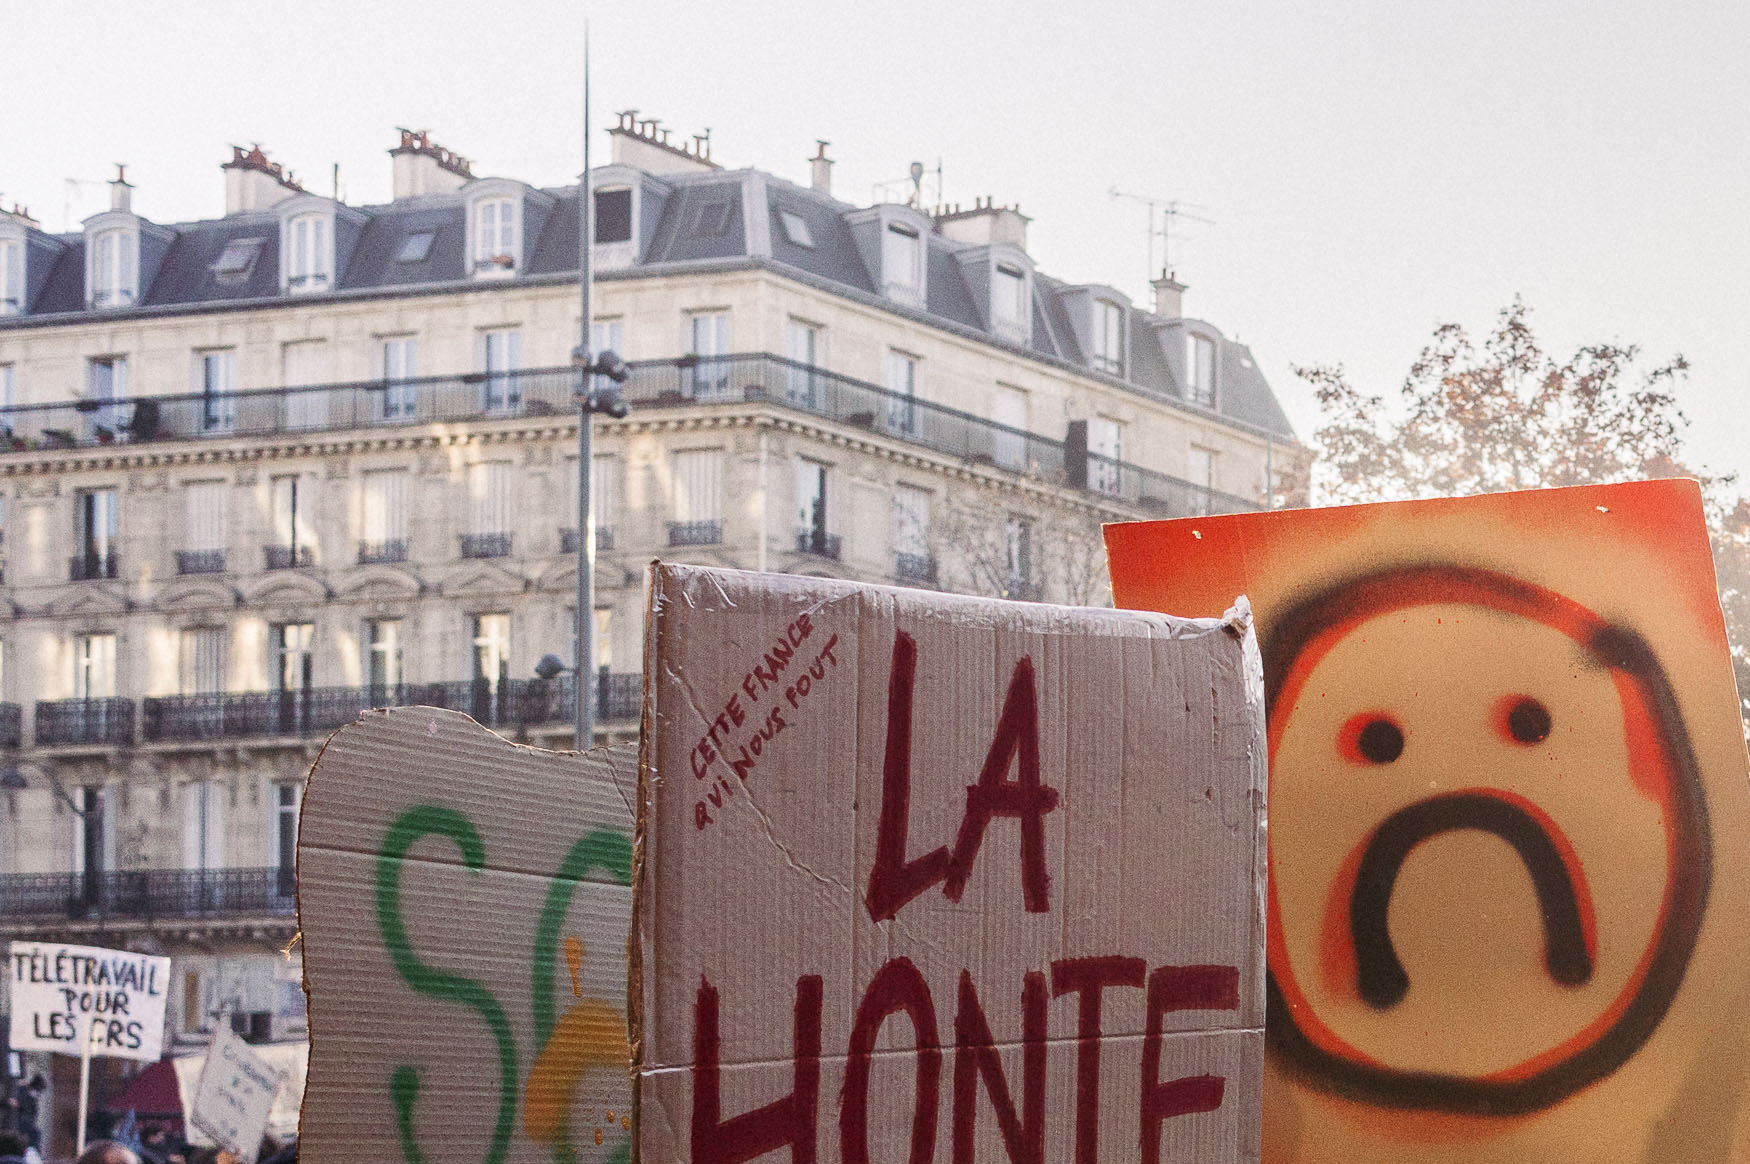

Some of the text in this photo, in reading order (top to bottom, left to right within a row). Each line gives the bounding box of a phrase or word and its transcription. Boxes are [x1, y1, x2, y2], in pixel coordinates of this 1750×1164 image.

[690, 613, 814, 780] CETTE FRANCE
[733, 706, 787, 781] NOUS
[786, 633, 838, 709] FOUT
[865, 629, 1059, 921] LA
[34, 1011, 143, 1049] LES CRS
[59, 988, 130, 1015] POUR
